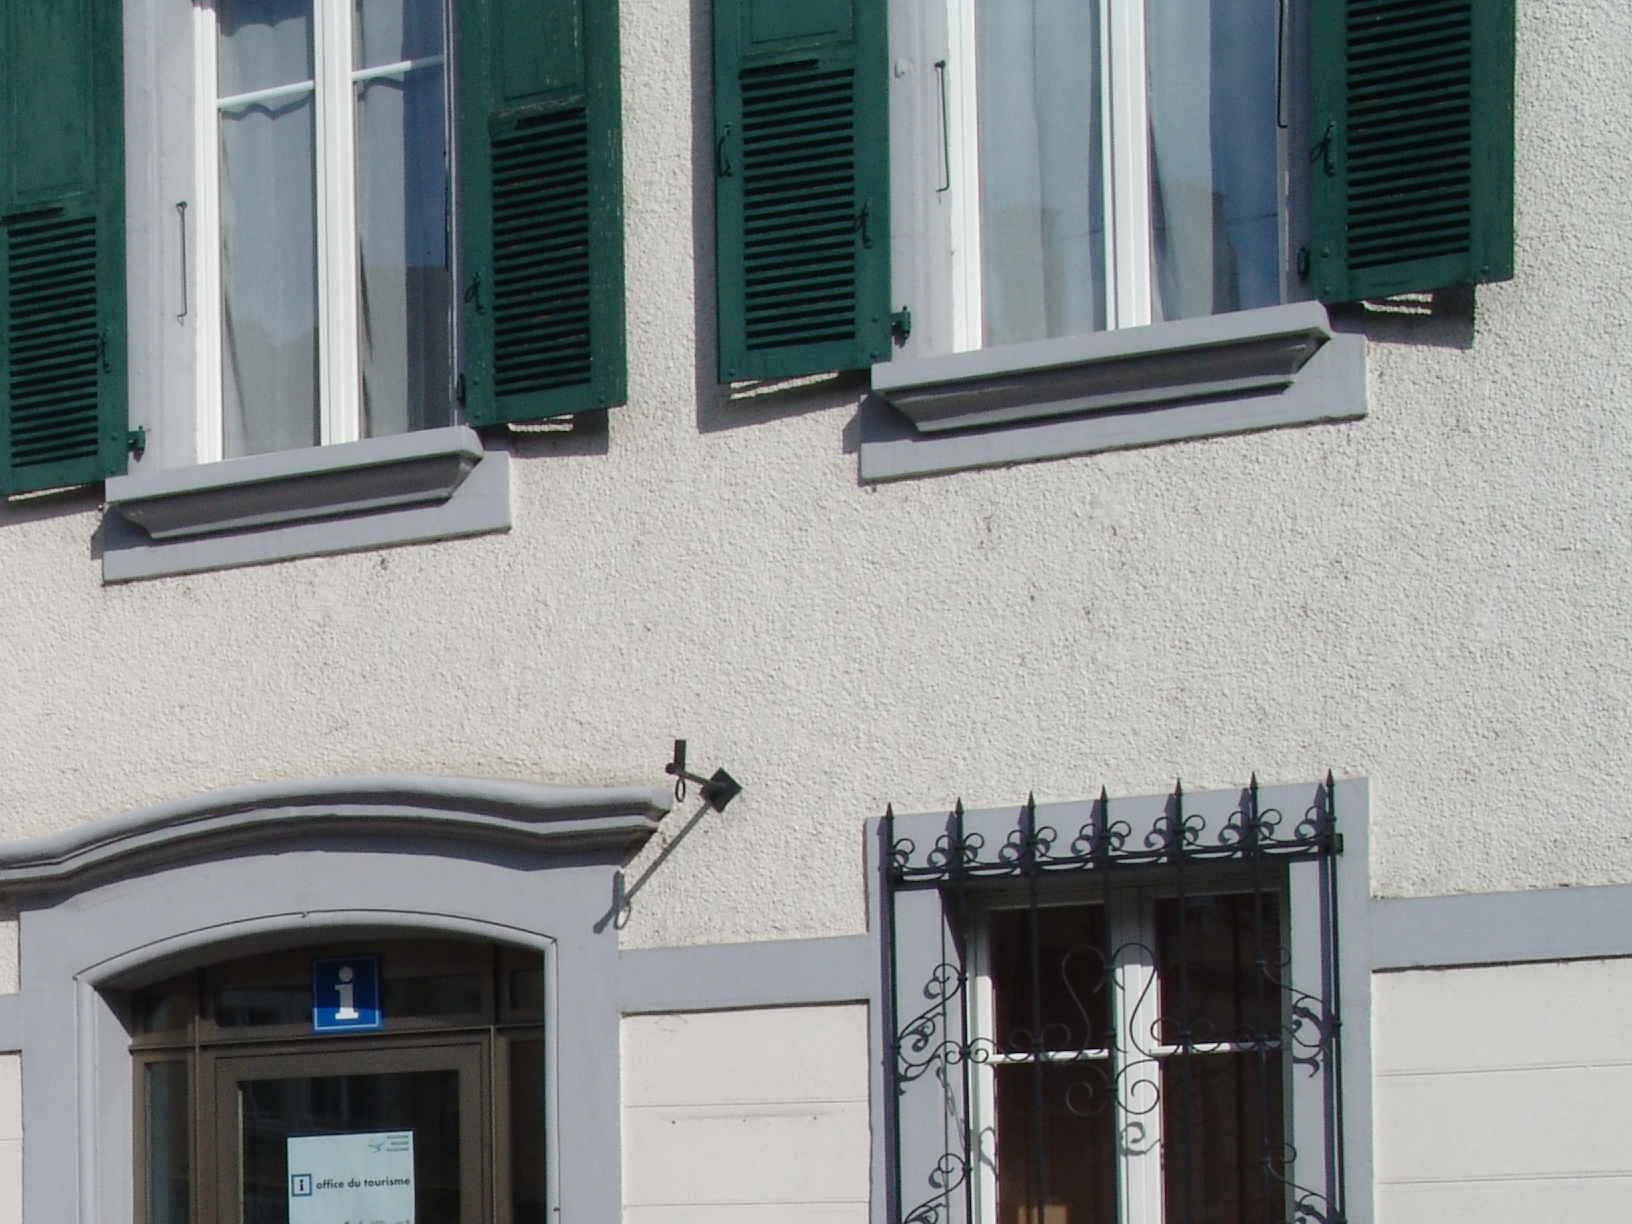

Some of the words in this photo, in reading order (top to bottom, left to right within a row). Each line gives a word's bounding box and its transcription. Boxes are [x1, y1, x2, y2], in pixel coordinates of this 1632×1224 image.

[335, 966, 359, 1020] i
[316, 1179, 344, 1190] office
[347, 1177, 361, 1188] du
[364, 1177, 411, 1188] tourisme
